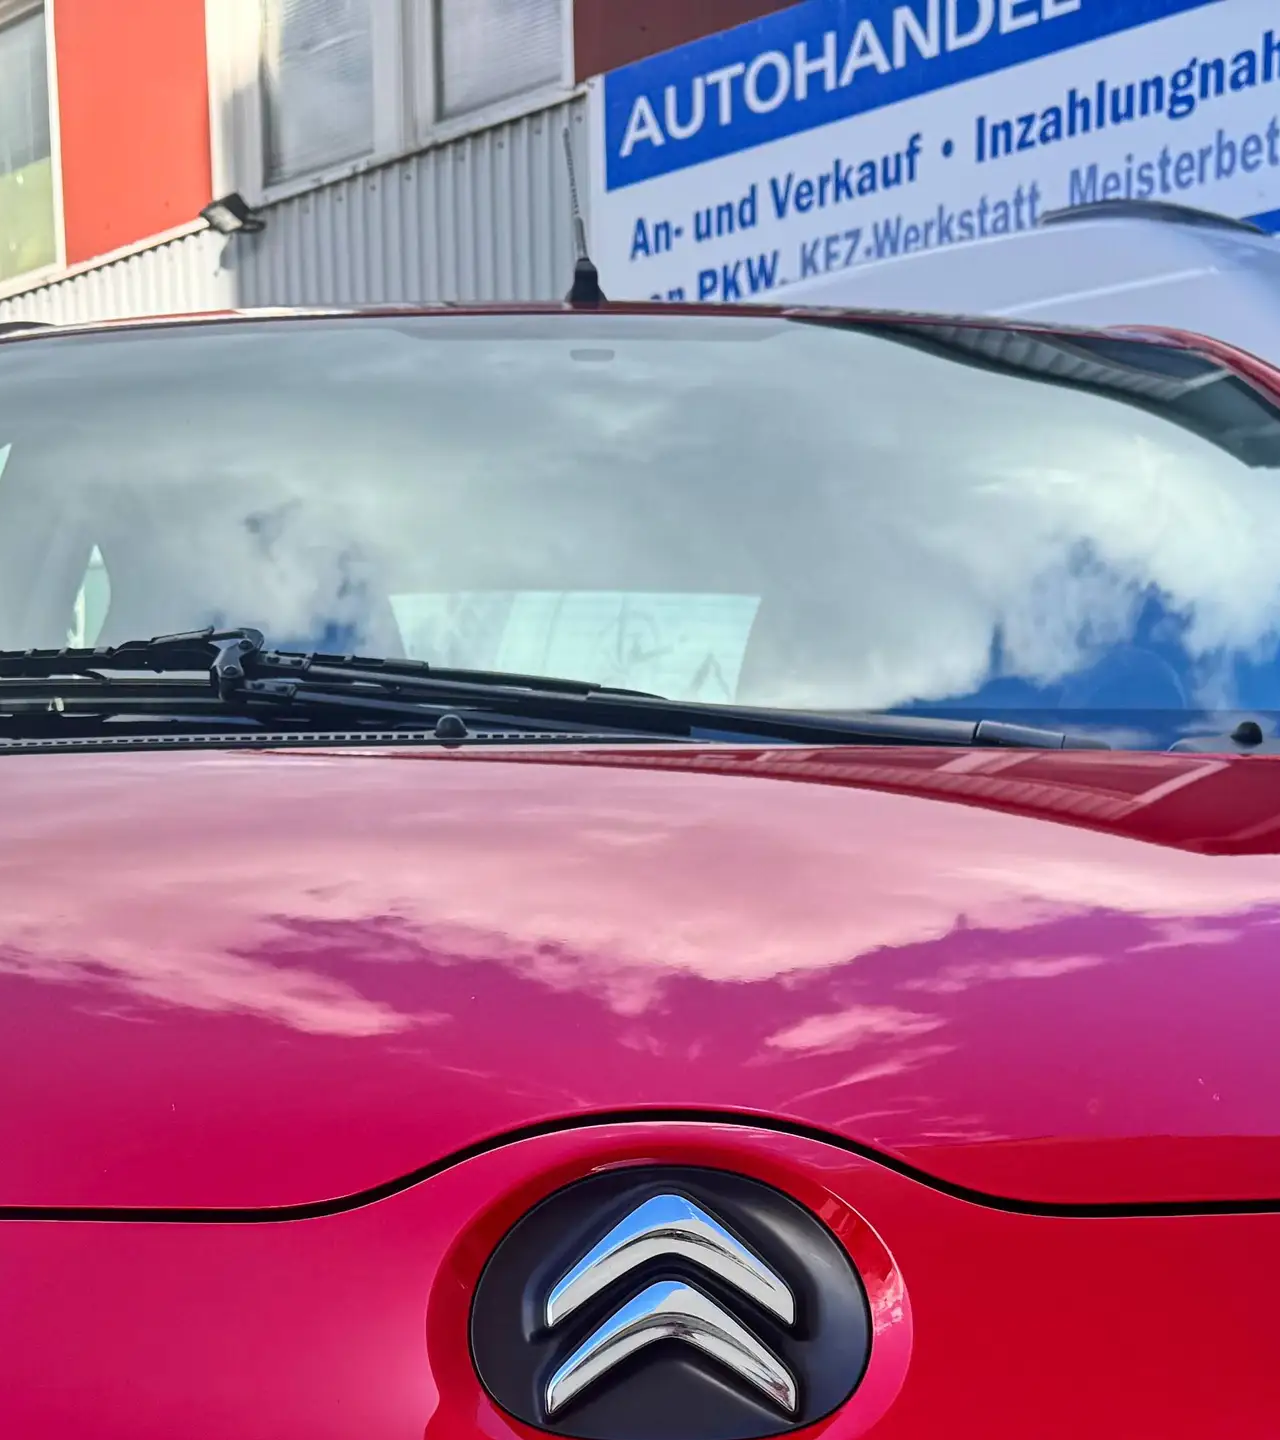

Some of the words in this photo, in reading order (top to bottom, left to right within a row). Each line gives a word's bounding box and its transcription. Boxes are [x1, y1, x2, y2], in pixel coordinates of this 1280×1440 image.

[629, 216, 685, 261] An-
[693, 183, 758, 243] und
[769, 133, 923, 220] Verkauf
